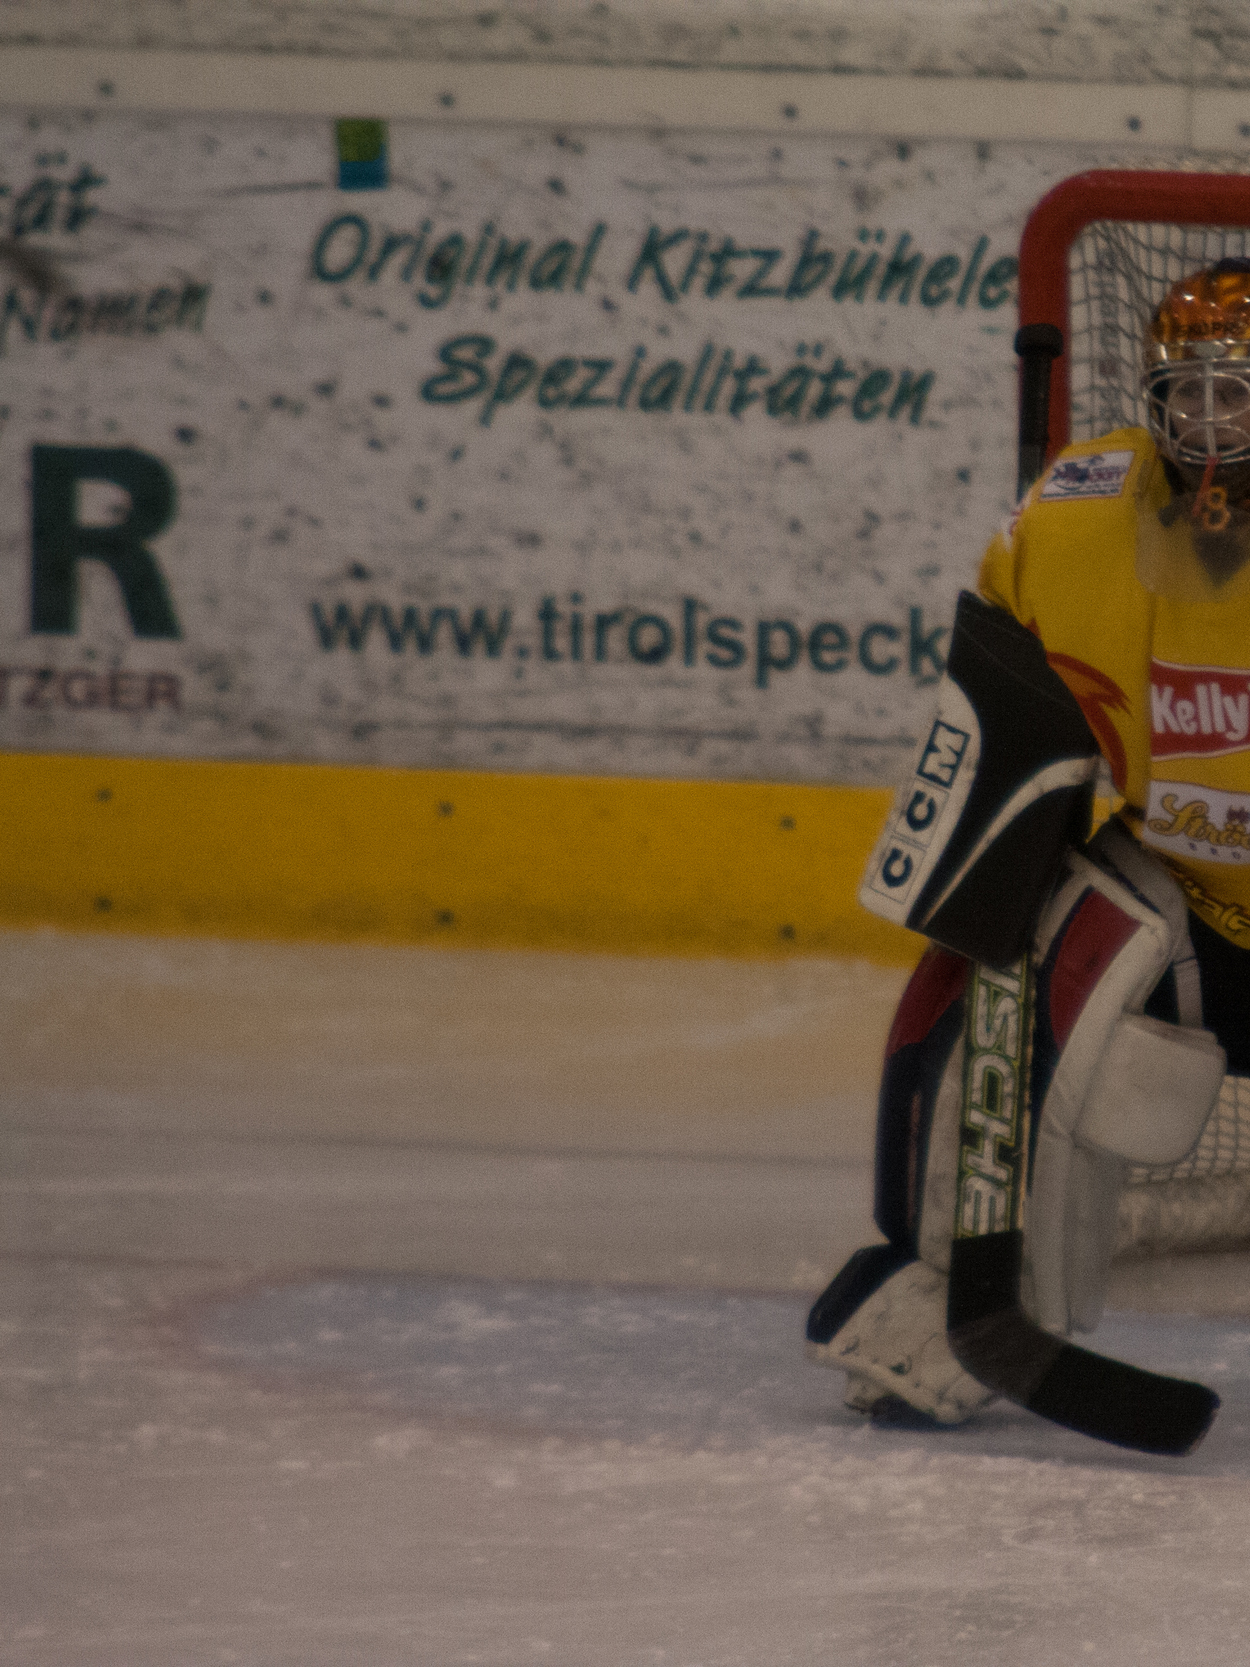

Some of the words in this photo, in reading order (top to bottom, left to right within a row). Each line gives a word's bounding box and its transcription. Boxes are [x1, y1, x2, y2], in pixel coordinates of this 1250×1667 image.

[0, 152, 108, 236] ät
[311, 213, 606, 308] Original
[626, 224, 1019, 309] Kitzbühele
[420, 334, 936, 428] Spezialitäten
[31, 443, 183, 640] R
[312, 590, 953, 689] www.tirolspeck
[882, 720, 970, 889] CCM
[958, 957, 1025, 1236] ISCHE
